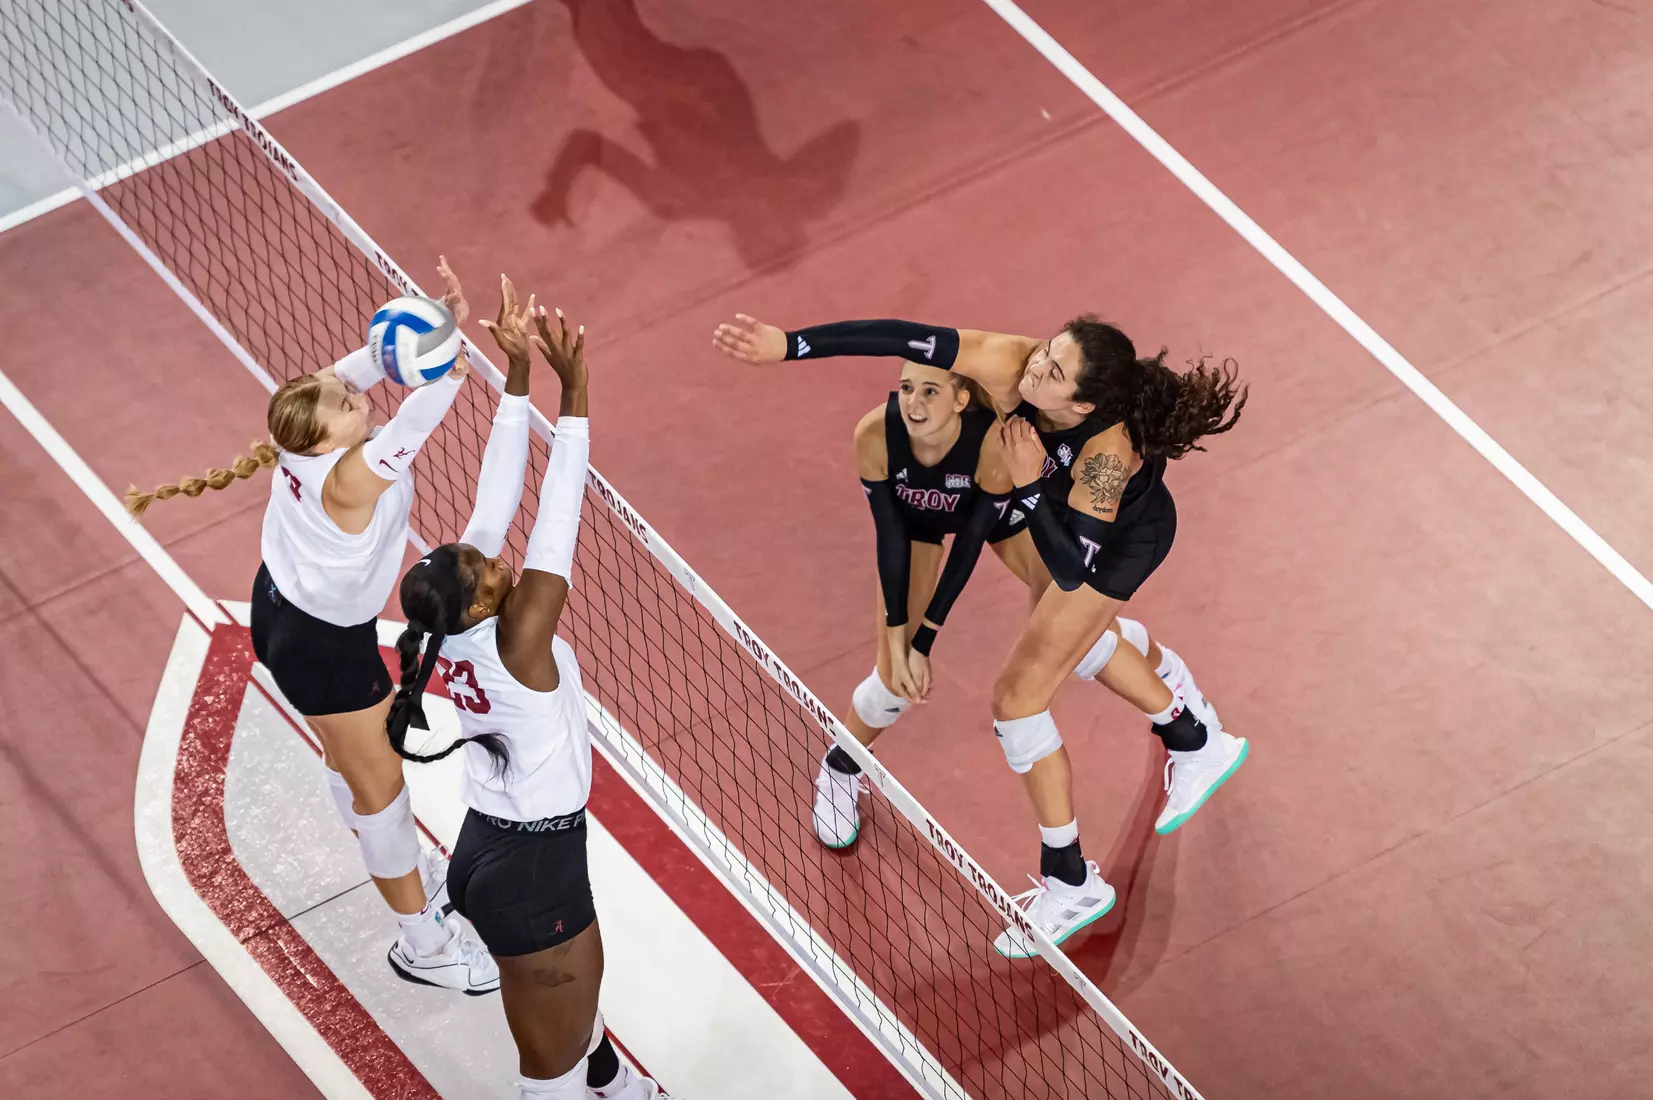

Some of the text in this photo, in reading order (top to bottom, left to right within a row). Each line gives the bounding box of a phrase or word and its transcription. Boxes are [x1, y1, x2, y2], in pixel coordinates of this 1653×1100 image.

[242, 112, 299, 182] TROJANS
[375, 250, 408, 292] TROY
[588, 469, 649, 544] TROJANS
[895, 483, 960, 512] TROY
[733, 619, 837, 736] TROY TROJANS
[517, 817, 574, 832] NIKE
[926, 818, 1035, 942] TROY TROJANS
[1128, 1029, 1169, 1080] TROY
